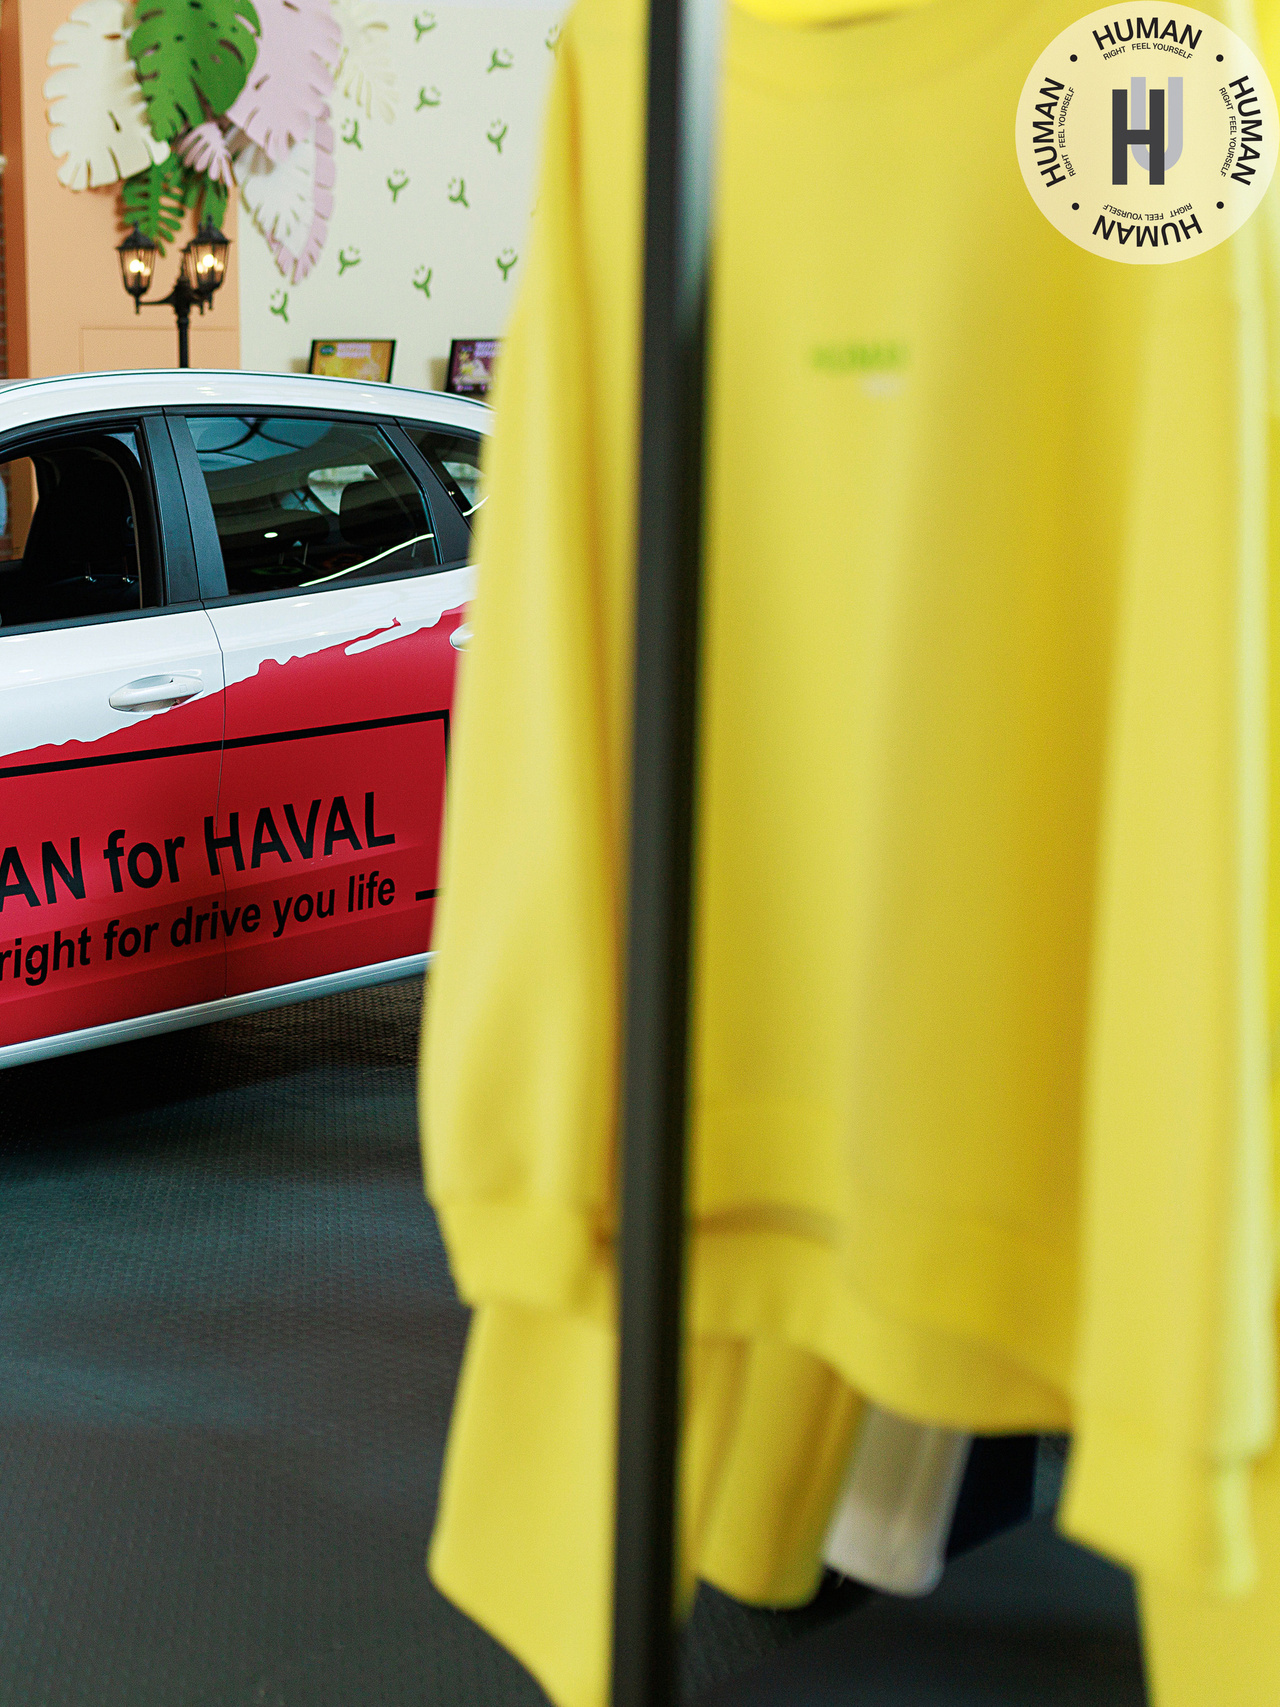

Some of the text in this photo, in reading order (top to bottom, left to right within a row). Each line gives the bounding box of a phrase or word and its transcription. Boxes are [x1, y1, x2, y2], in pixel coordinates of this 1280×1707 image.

[103, 829, 186, 894] for
[203, 791, 396, 877] HAVAL
[104, 919, 160, 961] for
[170, 885, 261, 948] drive
[272, 888, 336, 938] you
[347, 870, 396, 913] life
